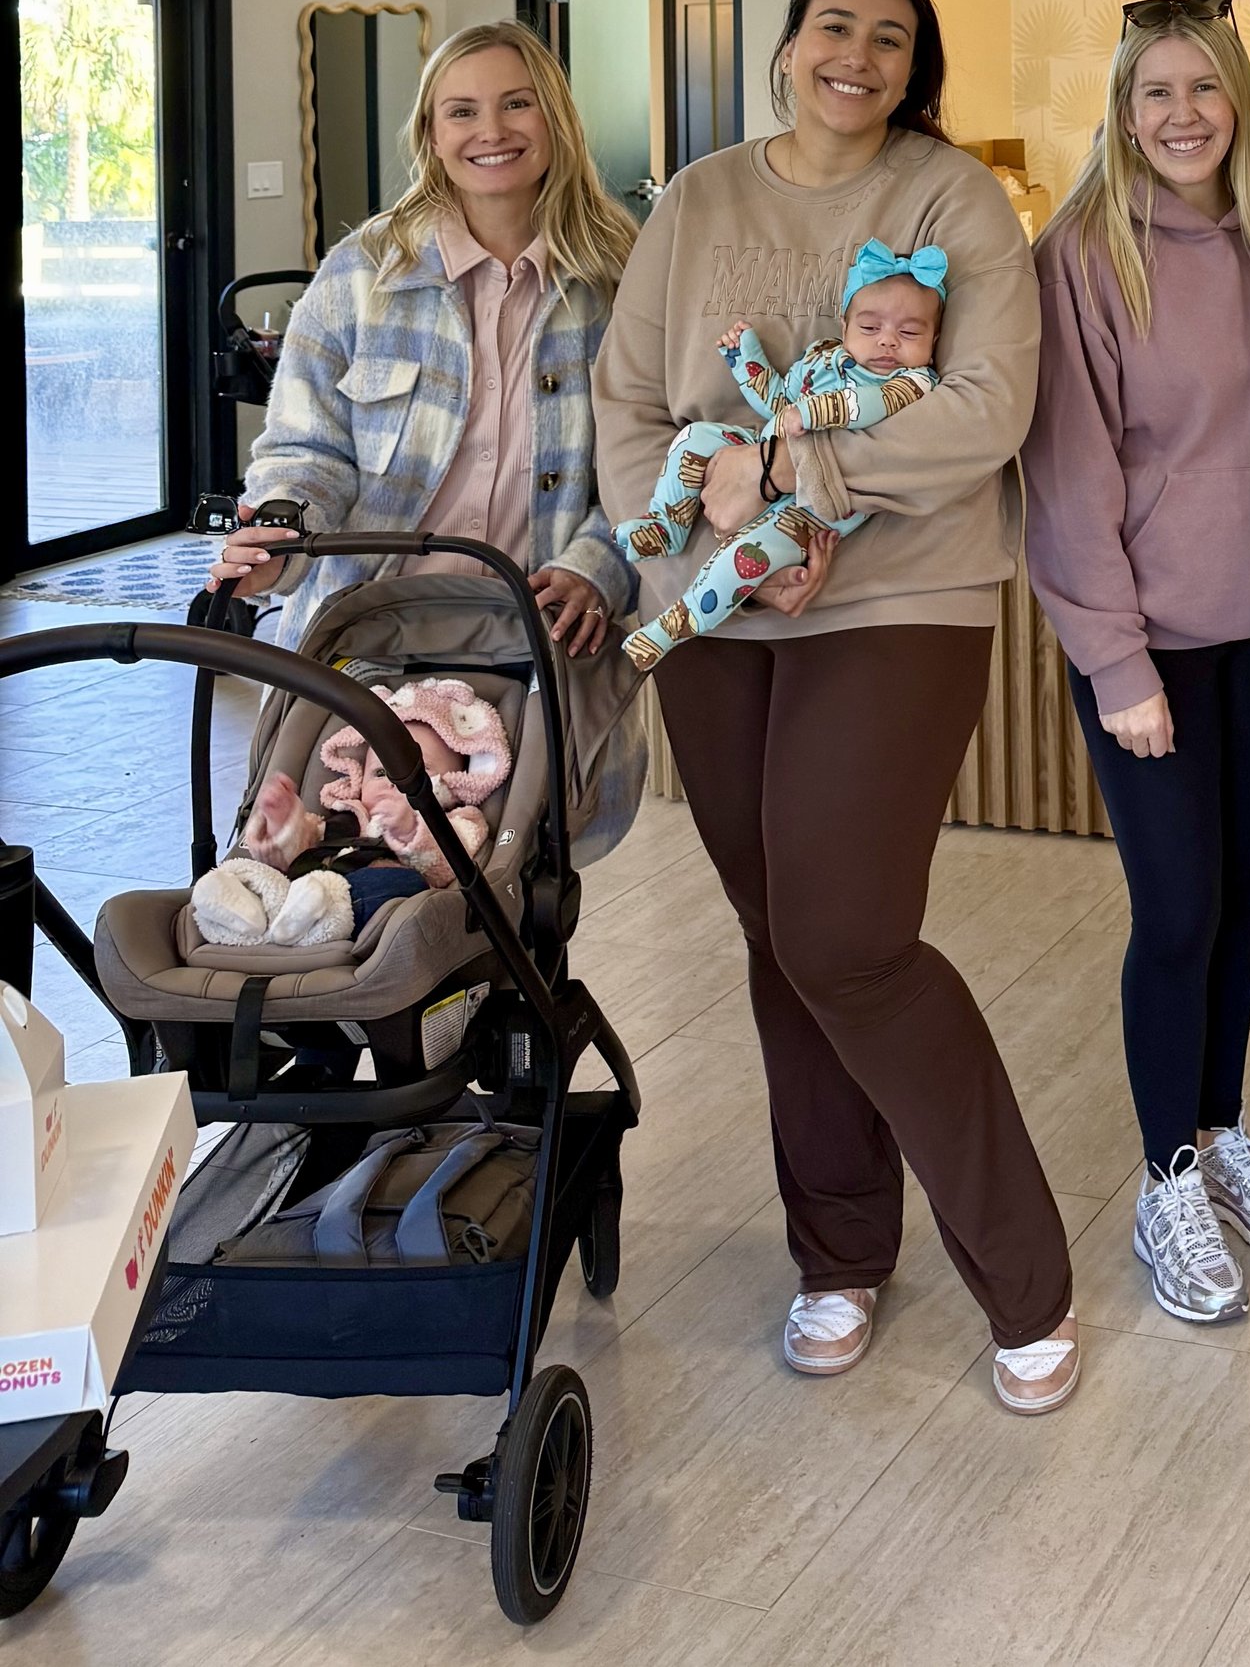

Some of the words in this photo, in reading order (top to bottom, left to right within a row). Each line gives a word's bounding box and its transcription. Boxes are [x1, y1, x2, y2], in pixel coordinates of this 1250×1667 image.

[702, 243, 864, 318] MAM
[0, 1357, 53, 1376] OZEN
[0, 1371, 62, 1392] ONUTS
